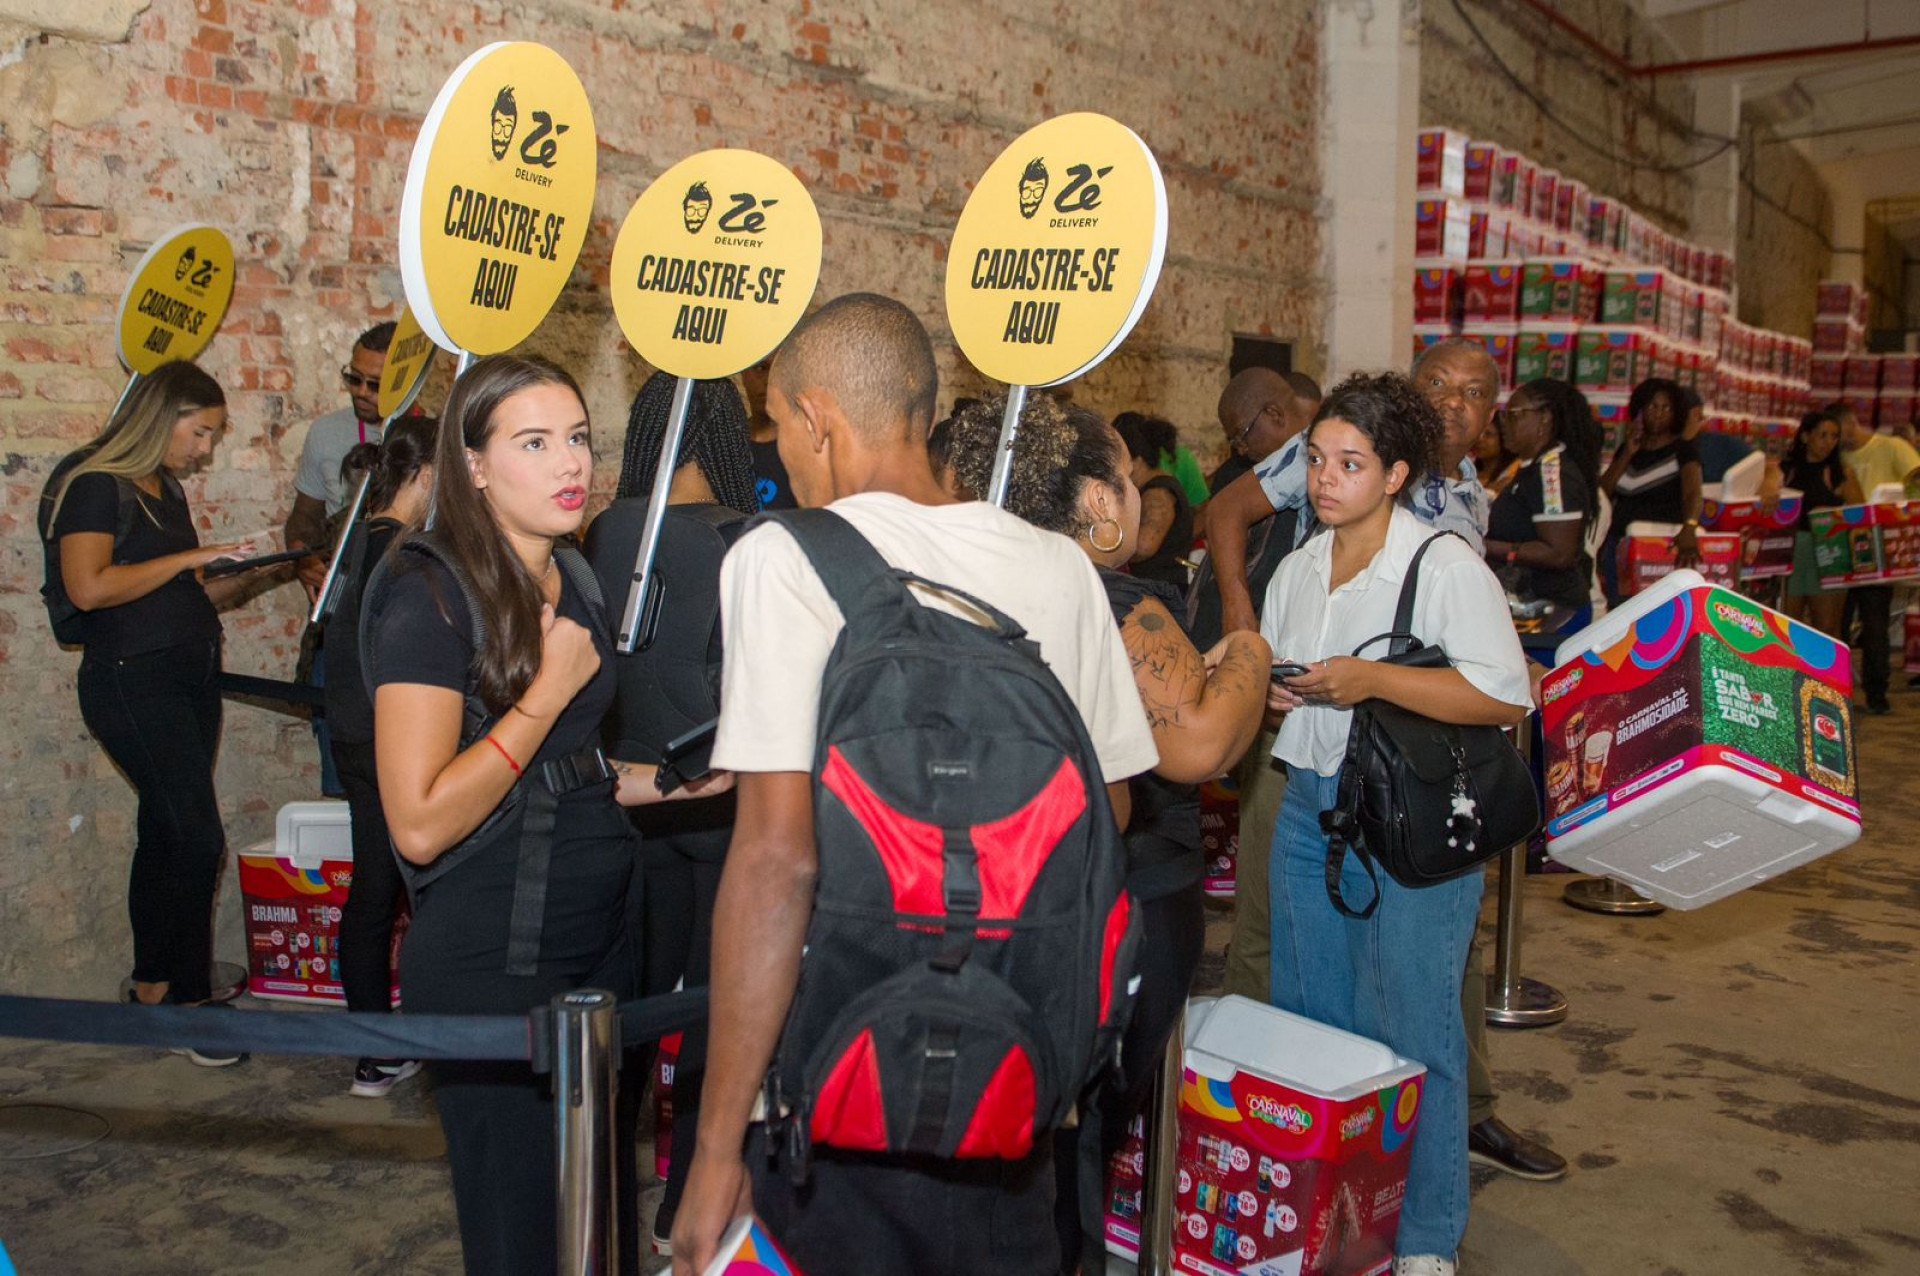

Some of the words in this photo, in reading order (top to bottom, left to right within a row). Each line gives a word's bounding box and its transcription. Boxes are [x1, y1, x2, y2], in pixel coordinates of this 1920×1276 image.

[520, 111, 570, 168] Zé
[515, 167, 553, 188] DELIVERY
[1054, 163, 1114, 213] Zé
[444, 185, 565, 261] CADASTRE-SE
[718, 193, 779, 234] Zé
[1050, 218, 1098, 228] DELIVERY
[714, 236, 764, 248] DELIVERY
[470, 257, 518, 311] AQUI
[637, 254, 785, 305] CADASTRE-SE
[971, 248, 1120, 291] CADASTRE-SE
[138, 288, 207, 335] CADASTRE-SE
[672, 304, 727, 345] AQUI
[1002, 301, 1060, 344] AQUI
[1616, 692, 1690, 746] BRAHMOSIDADE
[1626, 695, 1672, 724] CARNAVAL
[1672, 687, 1686, 699] DA
[1719, 704, 1760, 728] ZERO
[251, 904, 298, 923] BRAHMA
[1250, 1097, 1309, 1127] CARNAVAL
